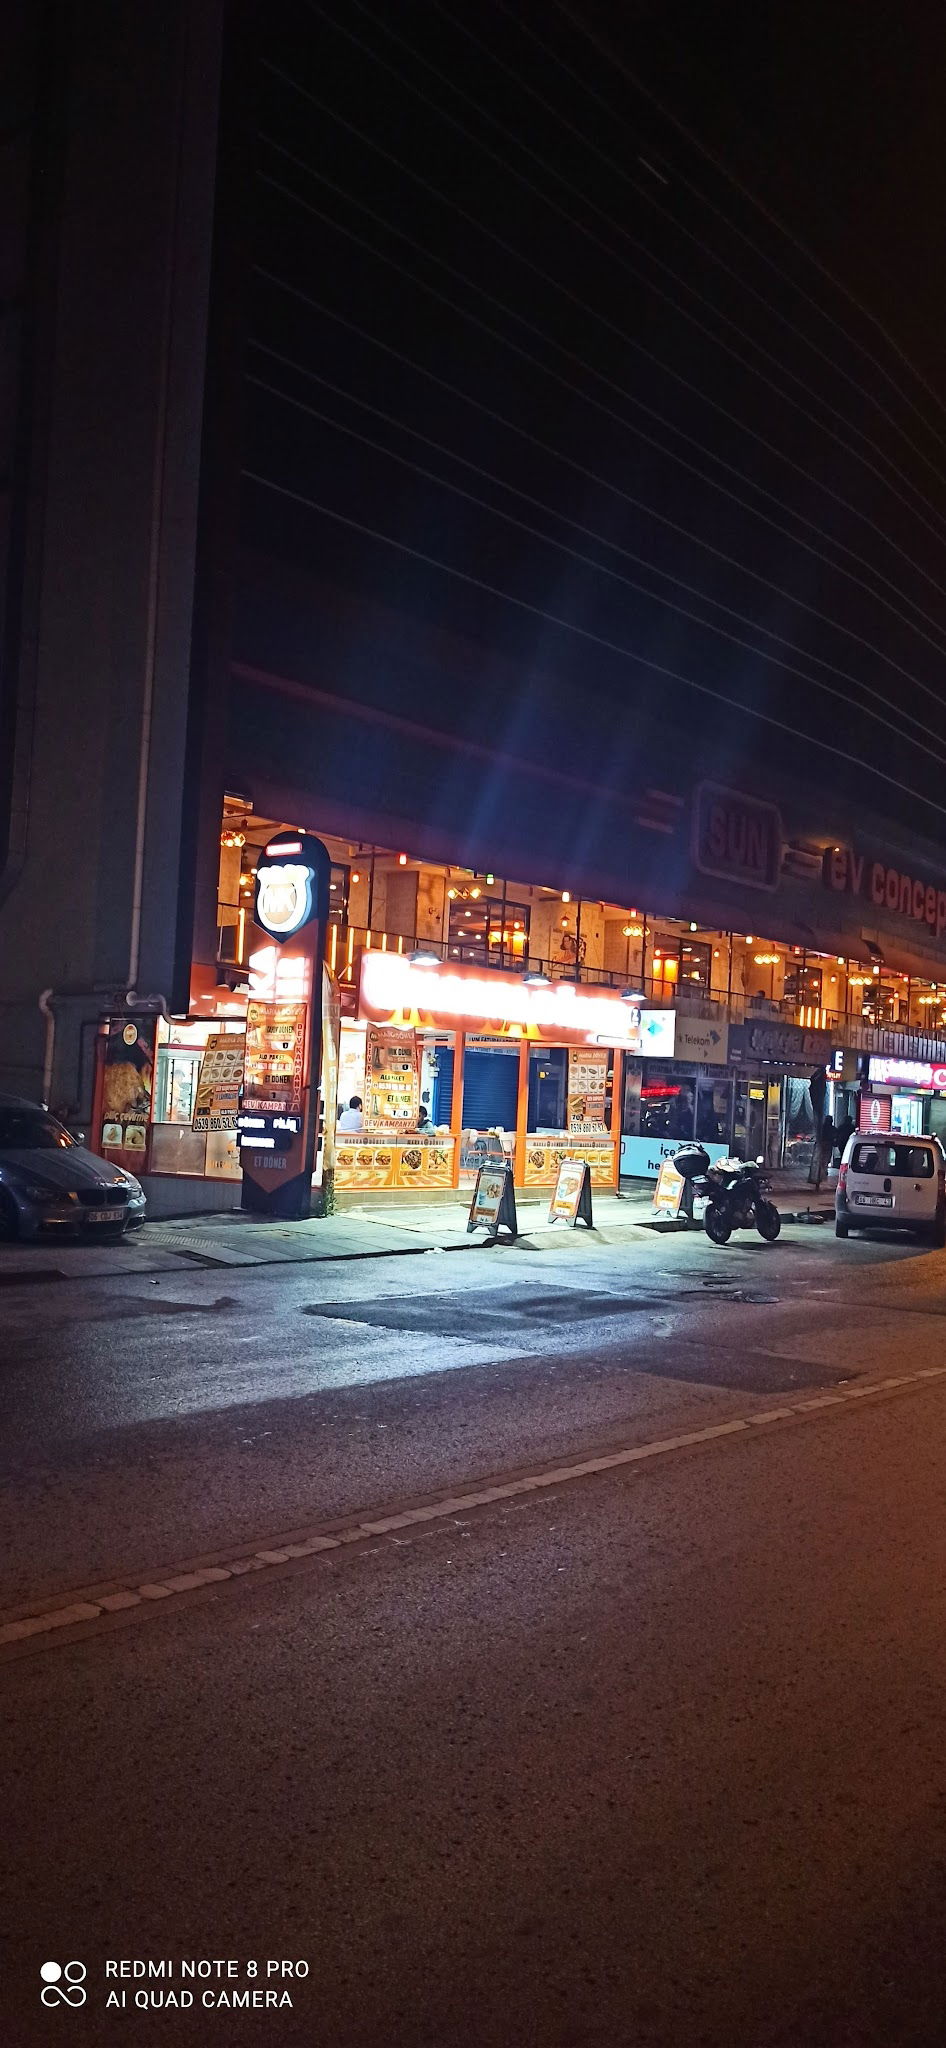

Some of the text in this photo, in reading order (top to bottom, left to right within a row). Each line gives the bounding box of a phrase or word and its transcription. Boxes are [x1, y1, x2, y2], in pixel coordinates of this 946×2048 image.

[709, 805, 768, 868] SUN
[830, 851, 865, 895] ev
[684, 1032, 711, 1047] Telekom
[365, 1119, 416, 1128] DEV KAMPANYA
